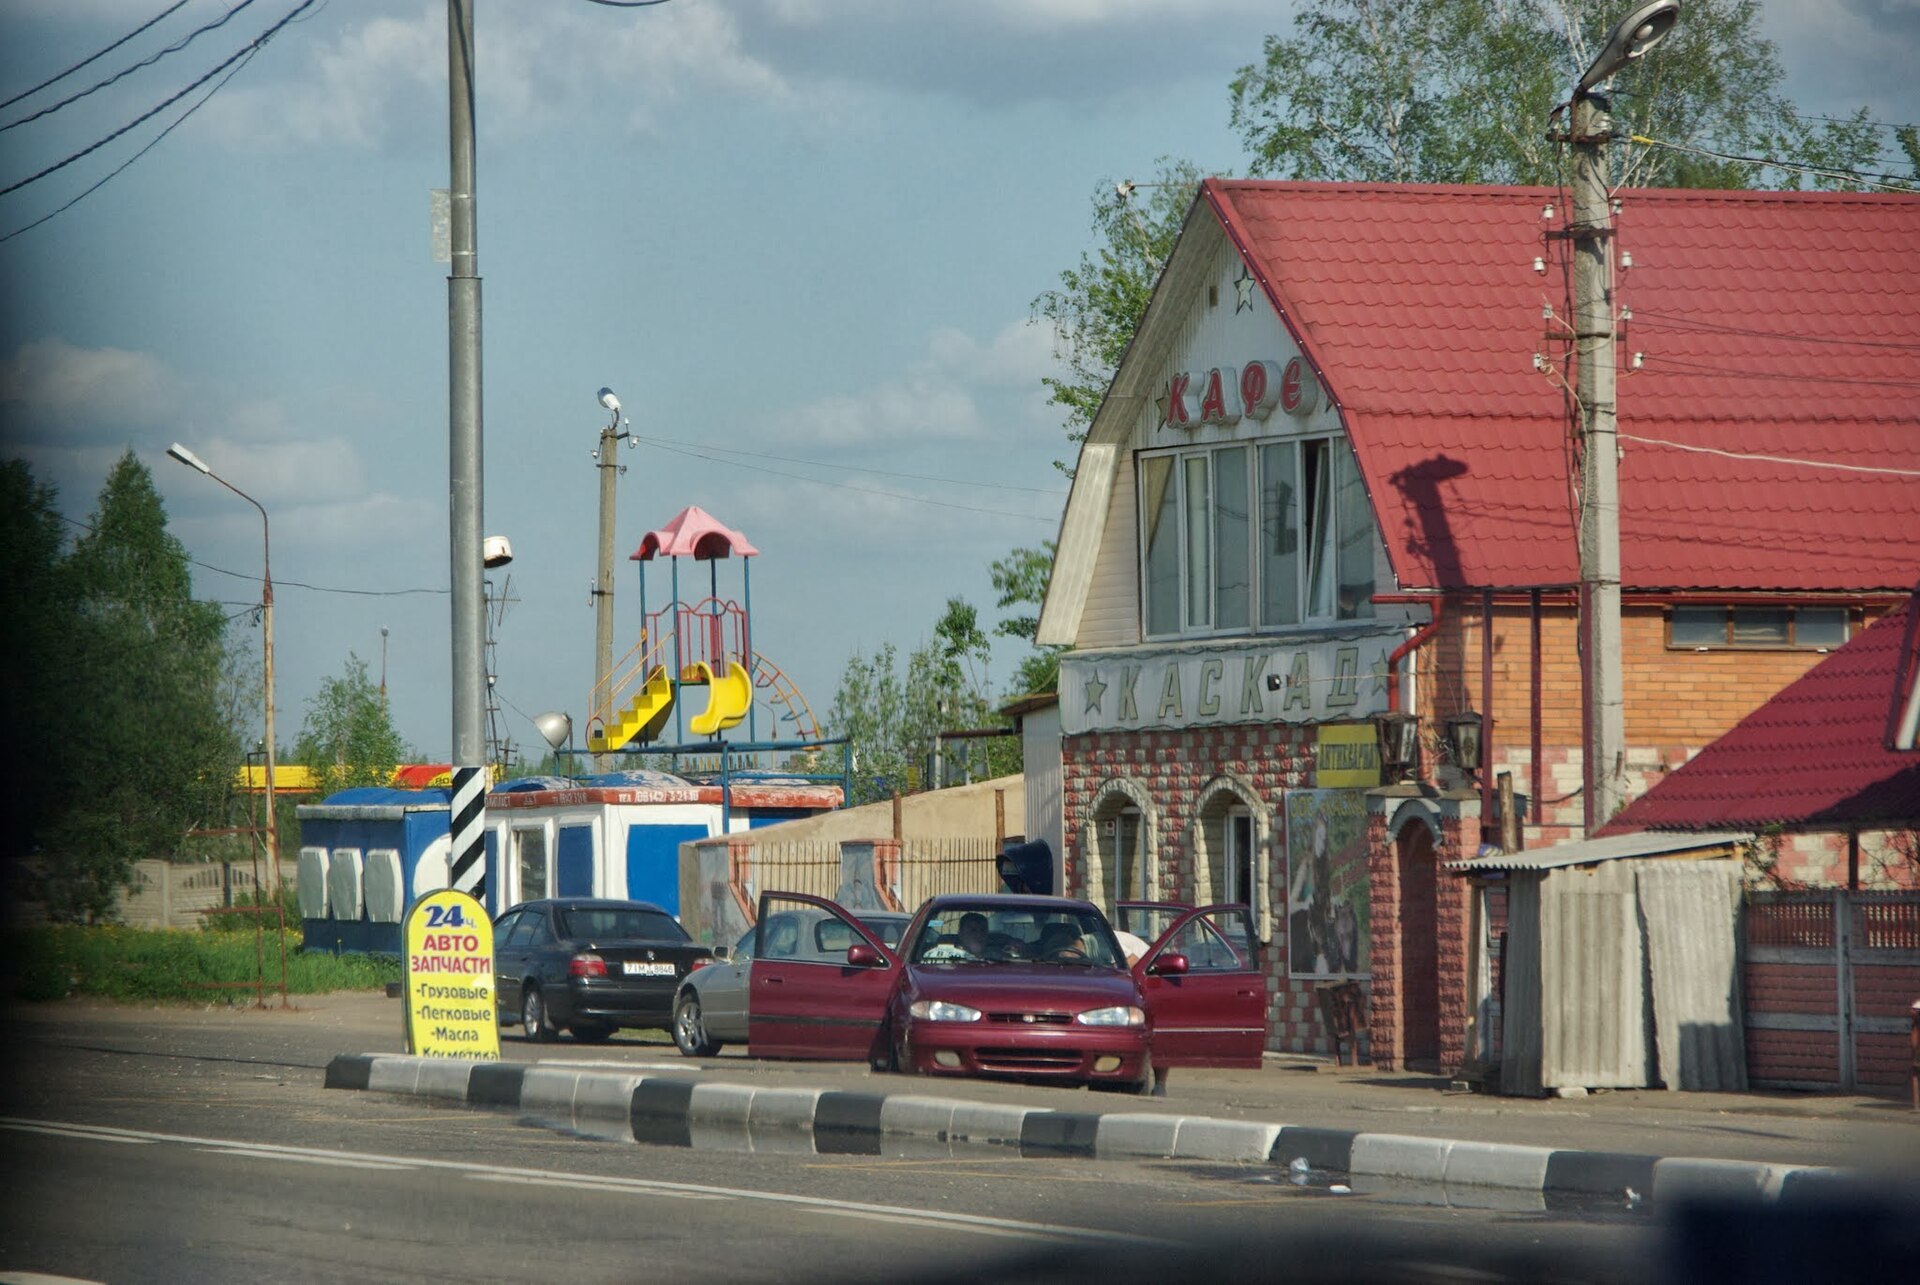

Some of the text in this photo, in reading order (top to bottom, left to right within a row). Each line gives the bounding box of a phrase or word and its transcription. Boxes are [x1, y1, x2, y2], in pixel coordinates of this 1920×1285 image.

[1167, 356, 1313, 430] КАФЕ
[1117, 648, 1360, 721] КАСКАД
[411, 956, 491, 974] ЗАПЧАСТИ
[423, 934, 479, 952] АВТО
